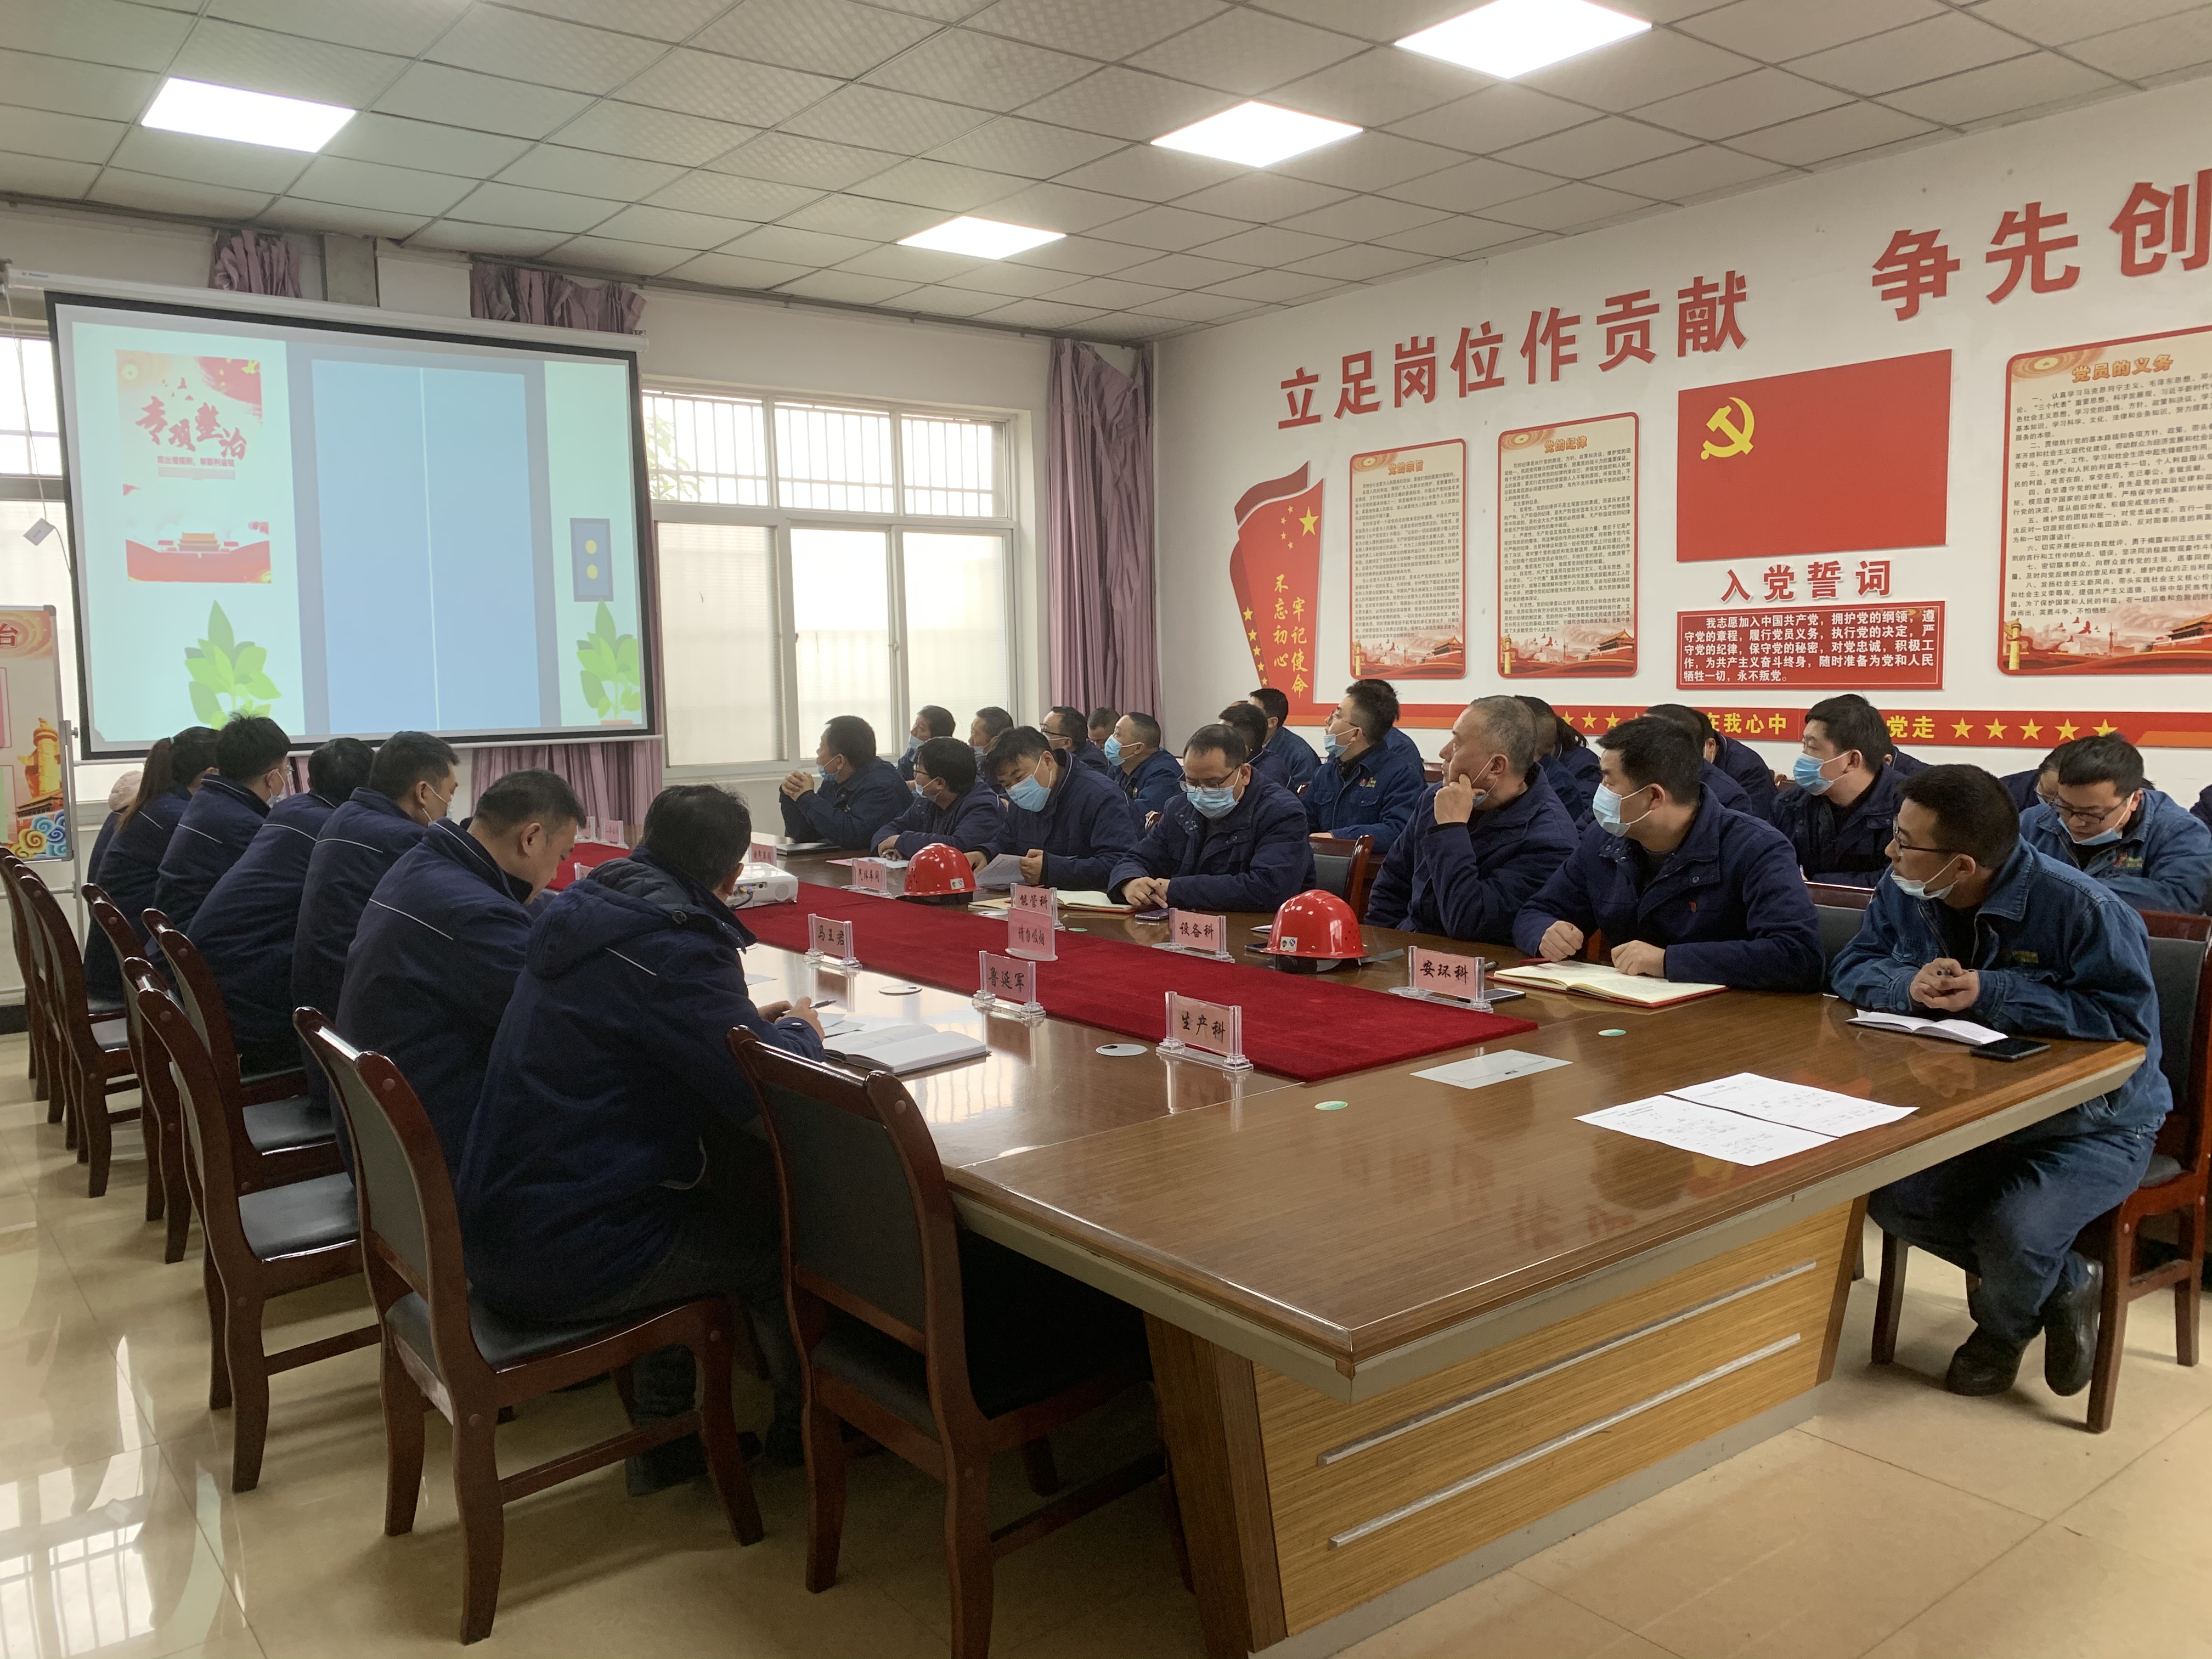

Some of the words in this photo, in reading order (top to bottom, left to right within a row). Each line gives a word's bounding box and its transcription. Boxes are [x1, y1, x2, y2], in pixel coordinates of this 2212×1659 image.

[1278, 270, 1748, 430] 立足岗位作贡献
[1872, 168, 2212, 321] 争先创
[2072, 354, 2174, 383] 党员的义务
[135, 396, 247, 460] 专项整治
[1544, 436, 1587, 453] 党的纪律
[1388, 460, 1424, 475] 党的宗旨
[1720, 560, 1891, 602] 入党誓词
[1273, 574, 1289, 668] 不忘初心
[1291, 597, 1308, 698] 牢记使命
[1707, 712, 1787, 735] 在我心中
[1887, 715, 1935, 738] 党走
[1020, 894, 1047, 910] 能管科
[1018, 924, 1045, 946] 请勿吸烟
[1180, 922, 1214, 940] 设备科
[988, 966, 1024, 992] 鲁延军
[1420, 960, 1468, 985] 安环科
[1181, 1011, 1225, 1043] 生产科
